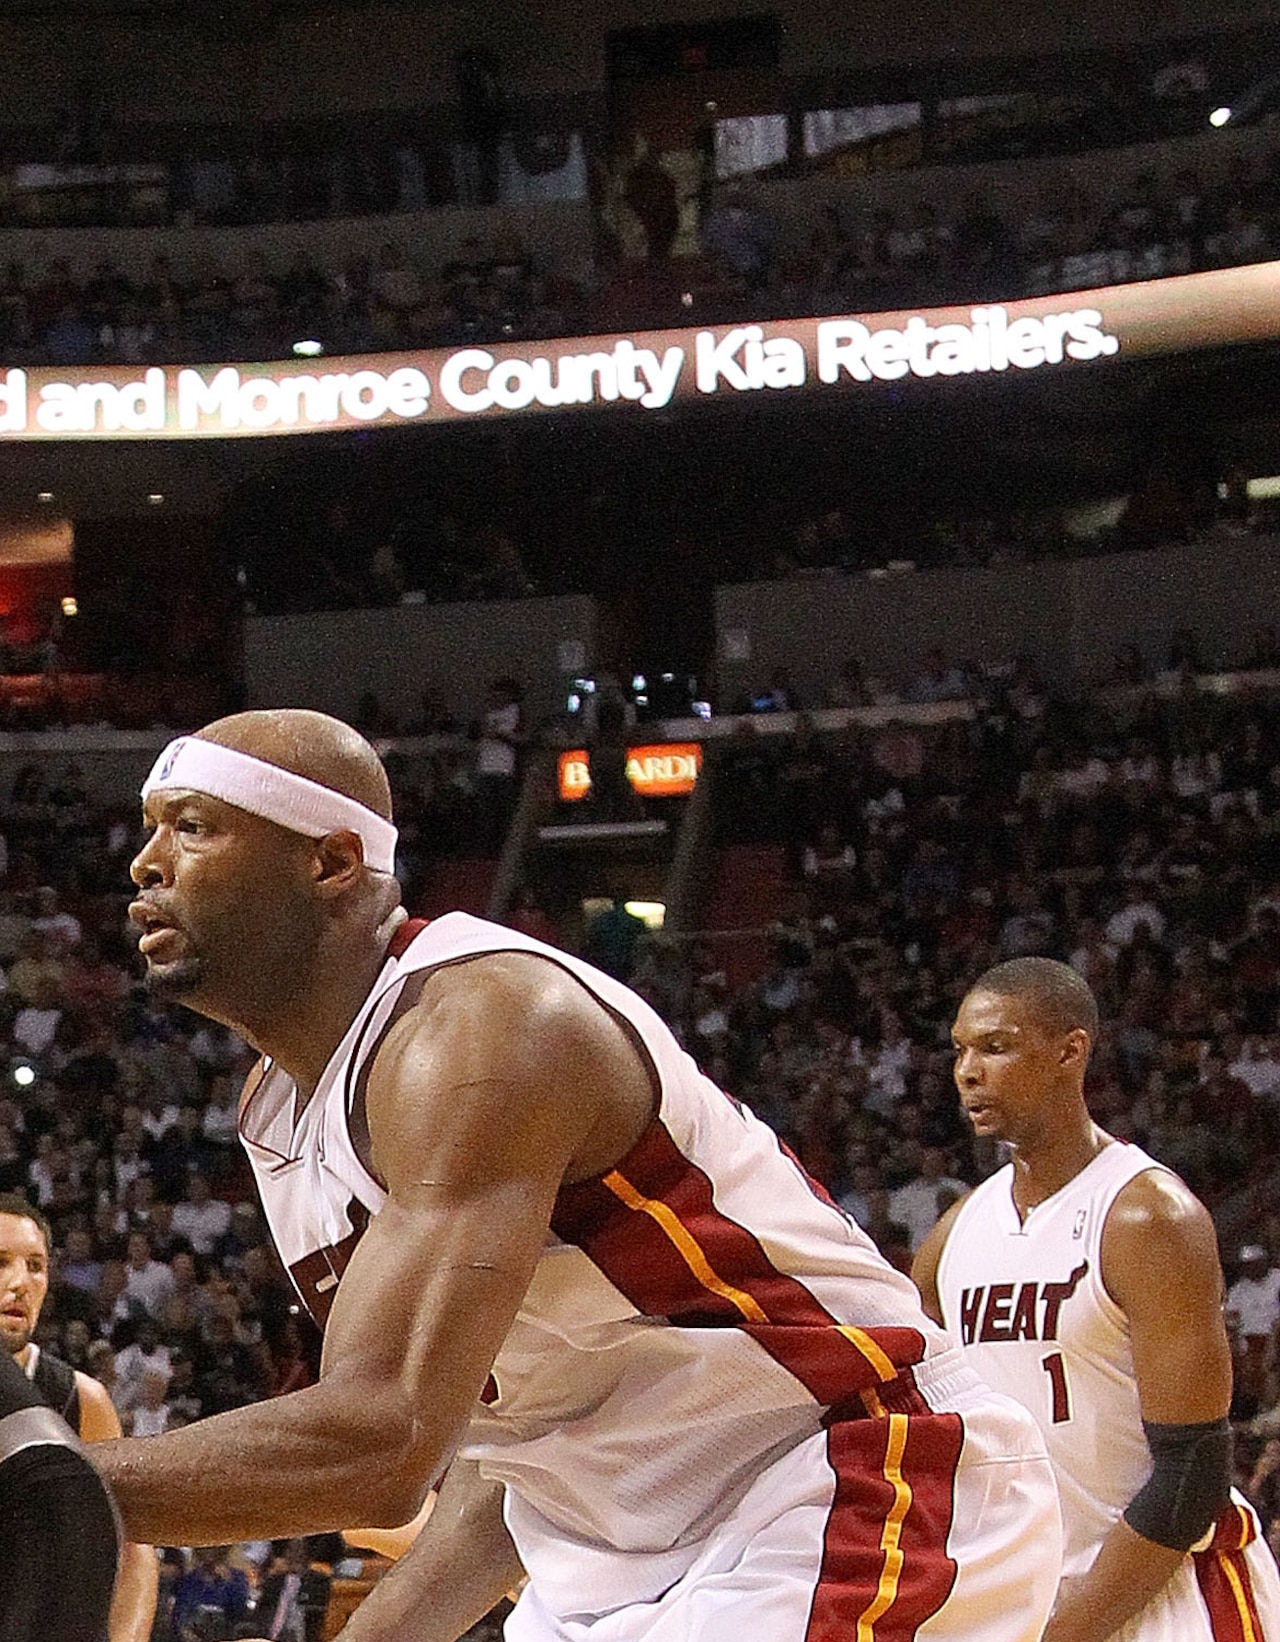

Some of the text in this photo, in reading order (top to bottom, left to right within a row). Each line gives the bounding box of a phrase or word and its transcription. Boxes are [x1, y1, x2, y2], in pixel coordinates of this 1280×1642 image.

[36, 367, 166, 431] and
[177, 366, 431, 430] Monroe
[439, 340, 684, 412] County
[695, 325, 806, 393] Kia
[817, 305, 1119, 384] Retailers.
[961, 1258, 1088, 1346] HEAT
[1041, 1352, 1071, 1424] 1
